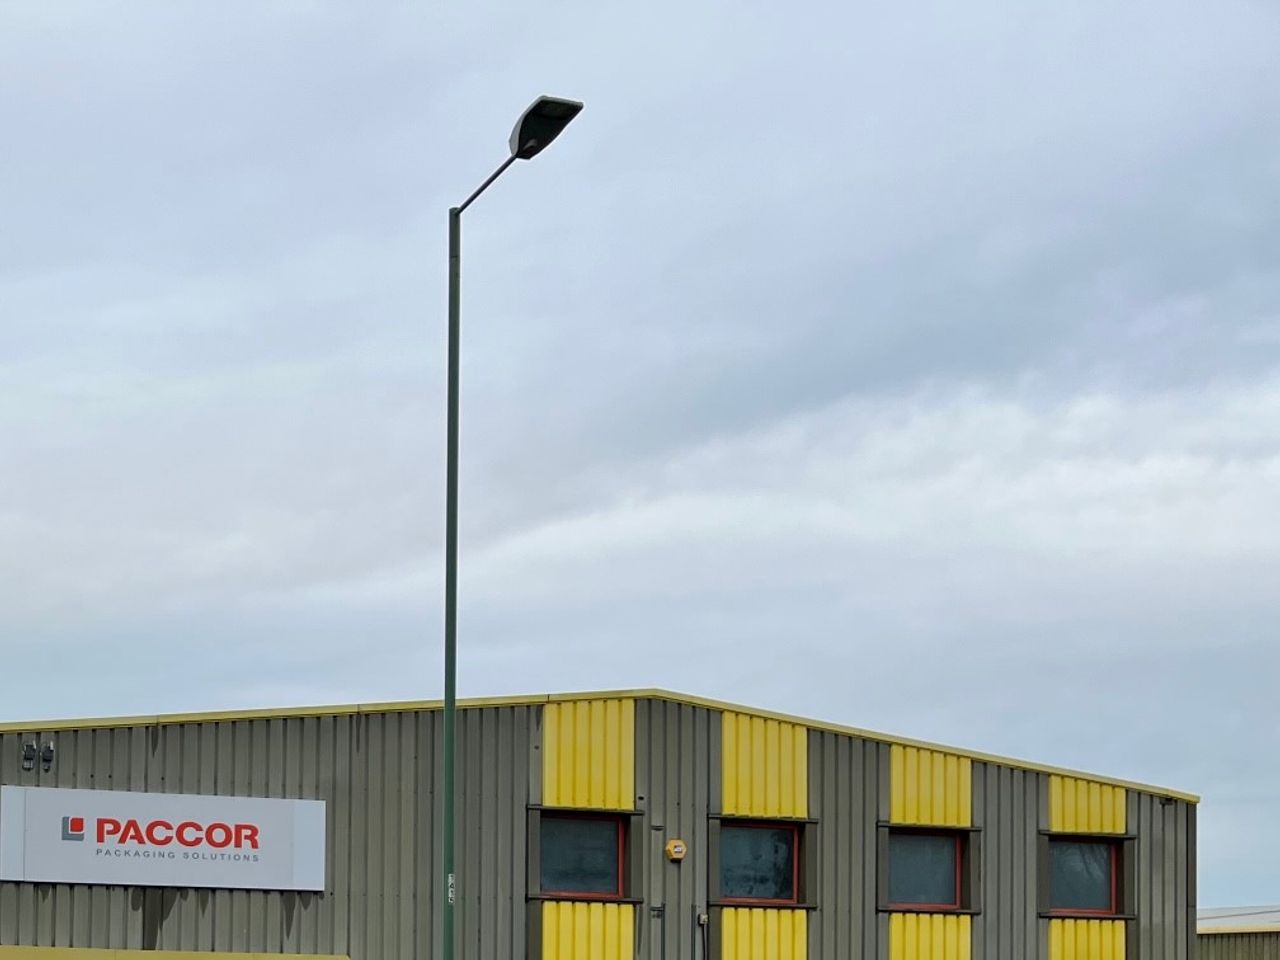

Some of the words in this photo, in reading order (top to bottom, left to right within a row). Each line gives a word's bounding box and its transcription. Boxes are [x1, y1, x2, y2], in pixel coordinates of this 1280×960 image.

[96, 817, 259, 849] PACCOR
[96, 848, 176, 859] PACKAGING
[183, 851, 259, 862] SOLUTIONS
